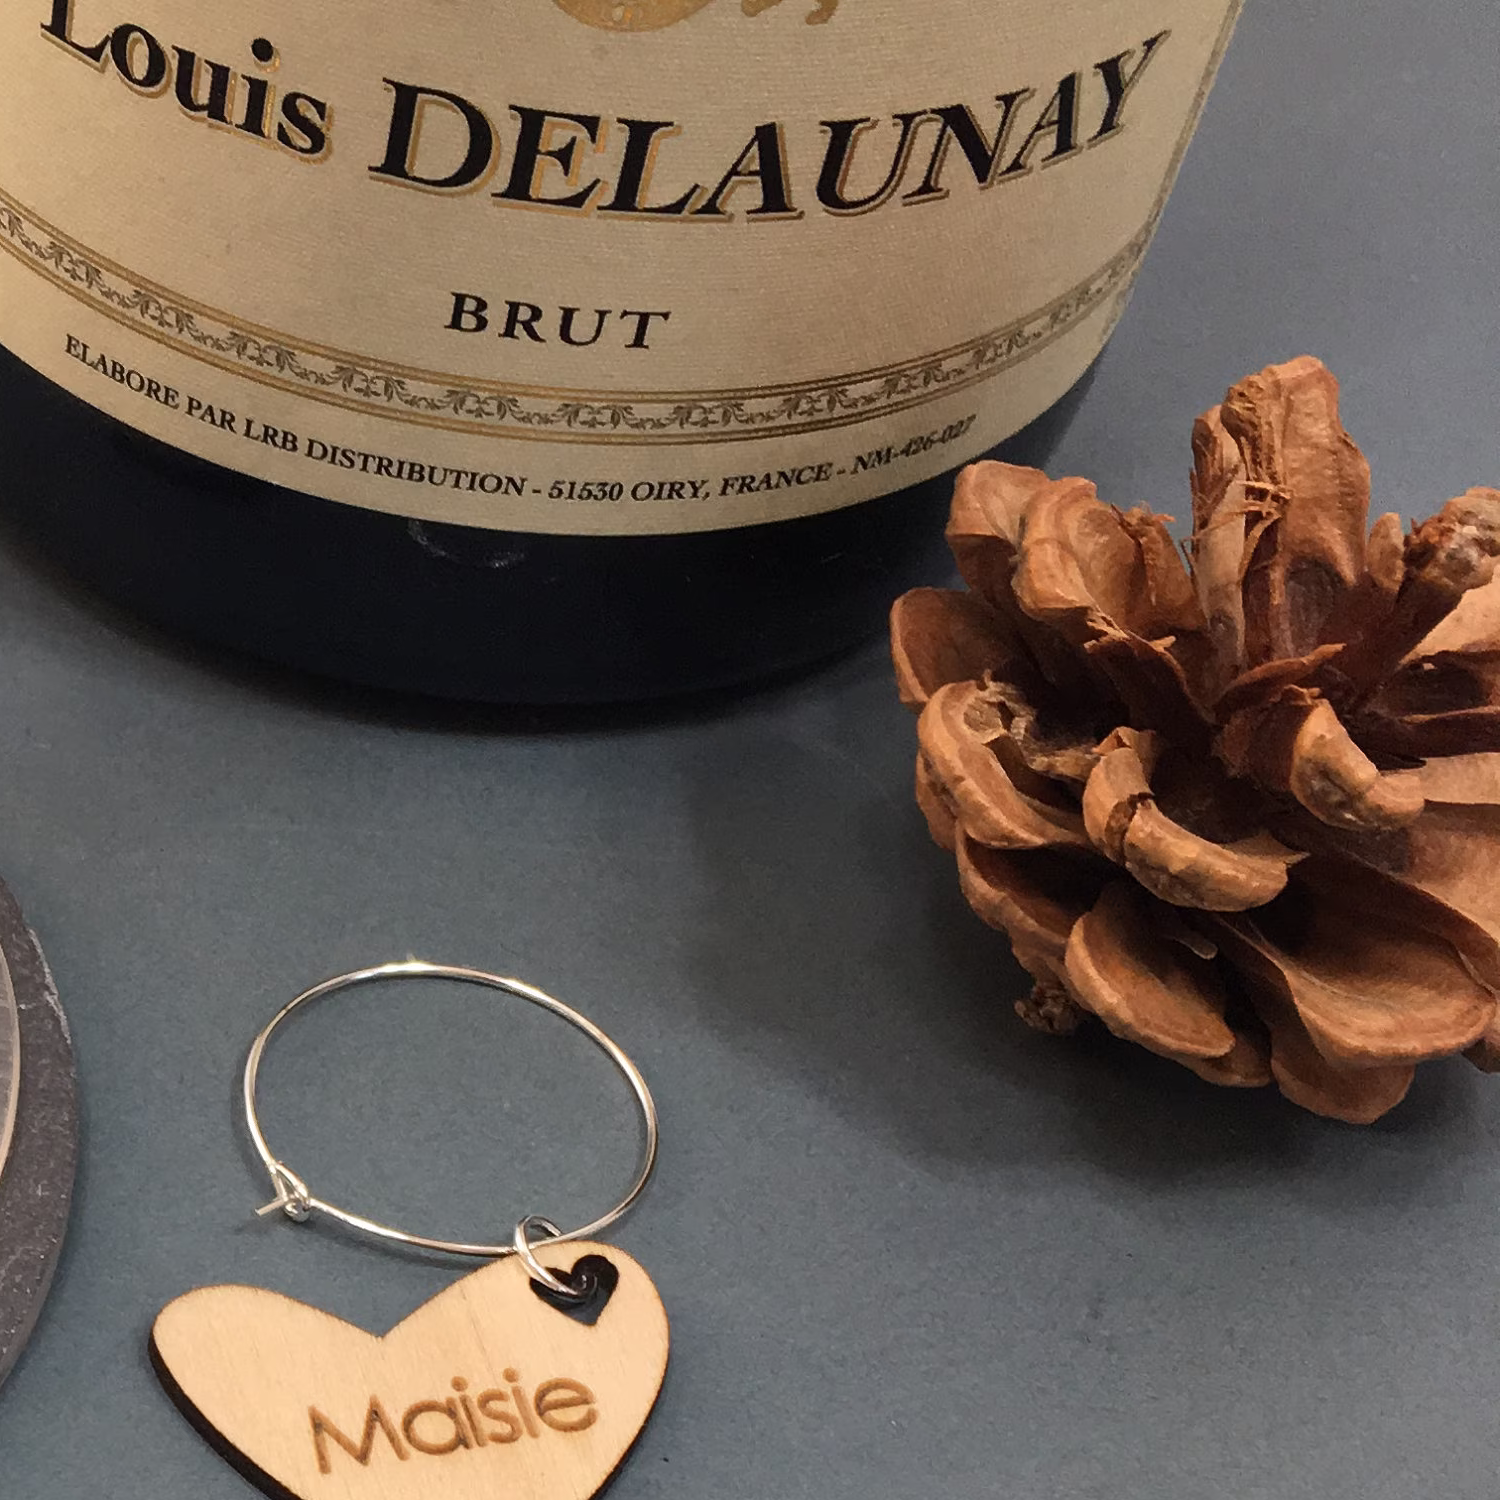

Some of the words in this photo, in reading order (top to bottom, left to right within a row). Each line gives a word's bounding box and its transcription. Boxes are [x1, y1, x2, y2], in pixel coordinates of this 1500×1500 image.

[368, 29, 1172, 224] DELAUNAY
[443, 291, 672, 350] BRUT
[65, 333, 180, 409] ELABORE
[185, 395, 237, 434] PAR
[243, 417, 299, 453] LRB
[304, 437, 528, 497] DISTRIBUTION
[548, 480, 624, 501] 51530
[630, 480, 711, 501] OIRY,
[717, 462, 834, 497] FRANCE
[308, 1367, 599, 1475] Maisie
